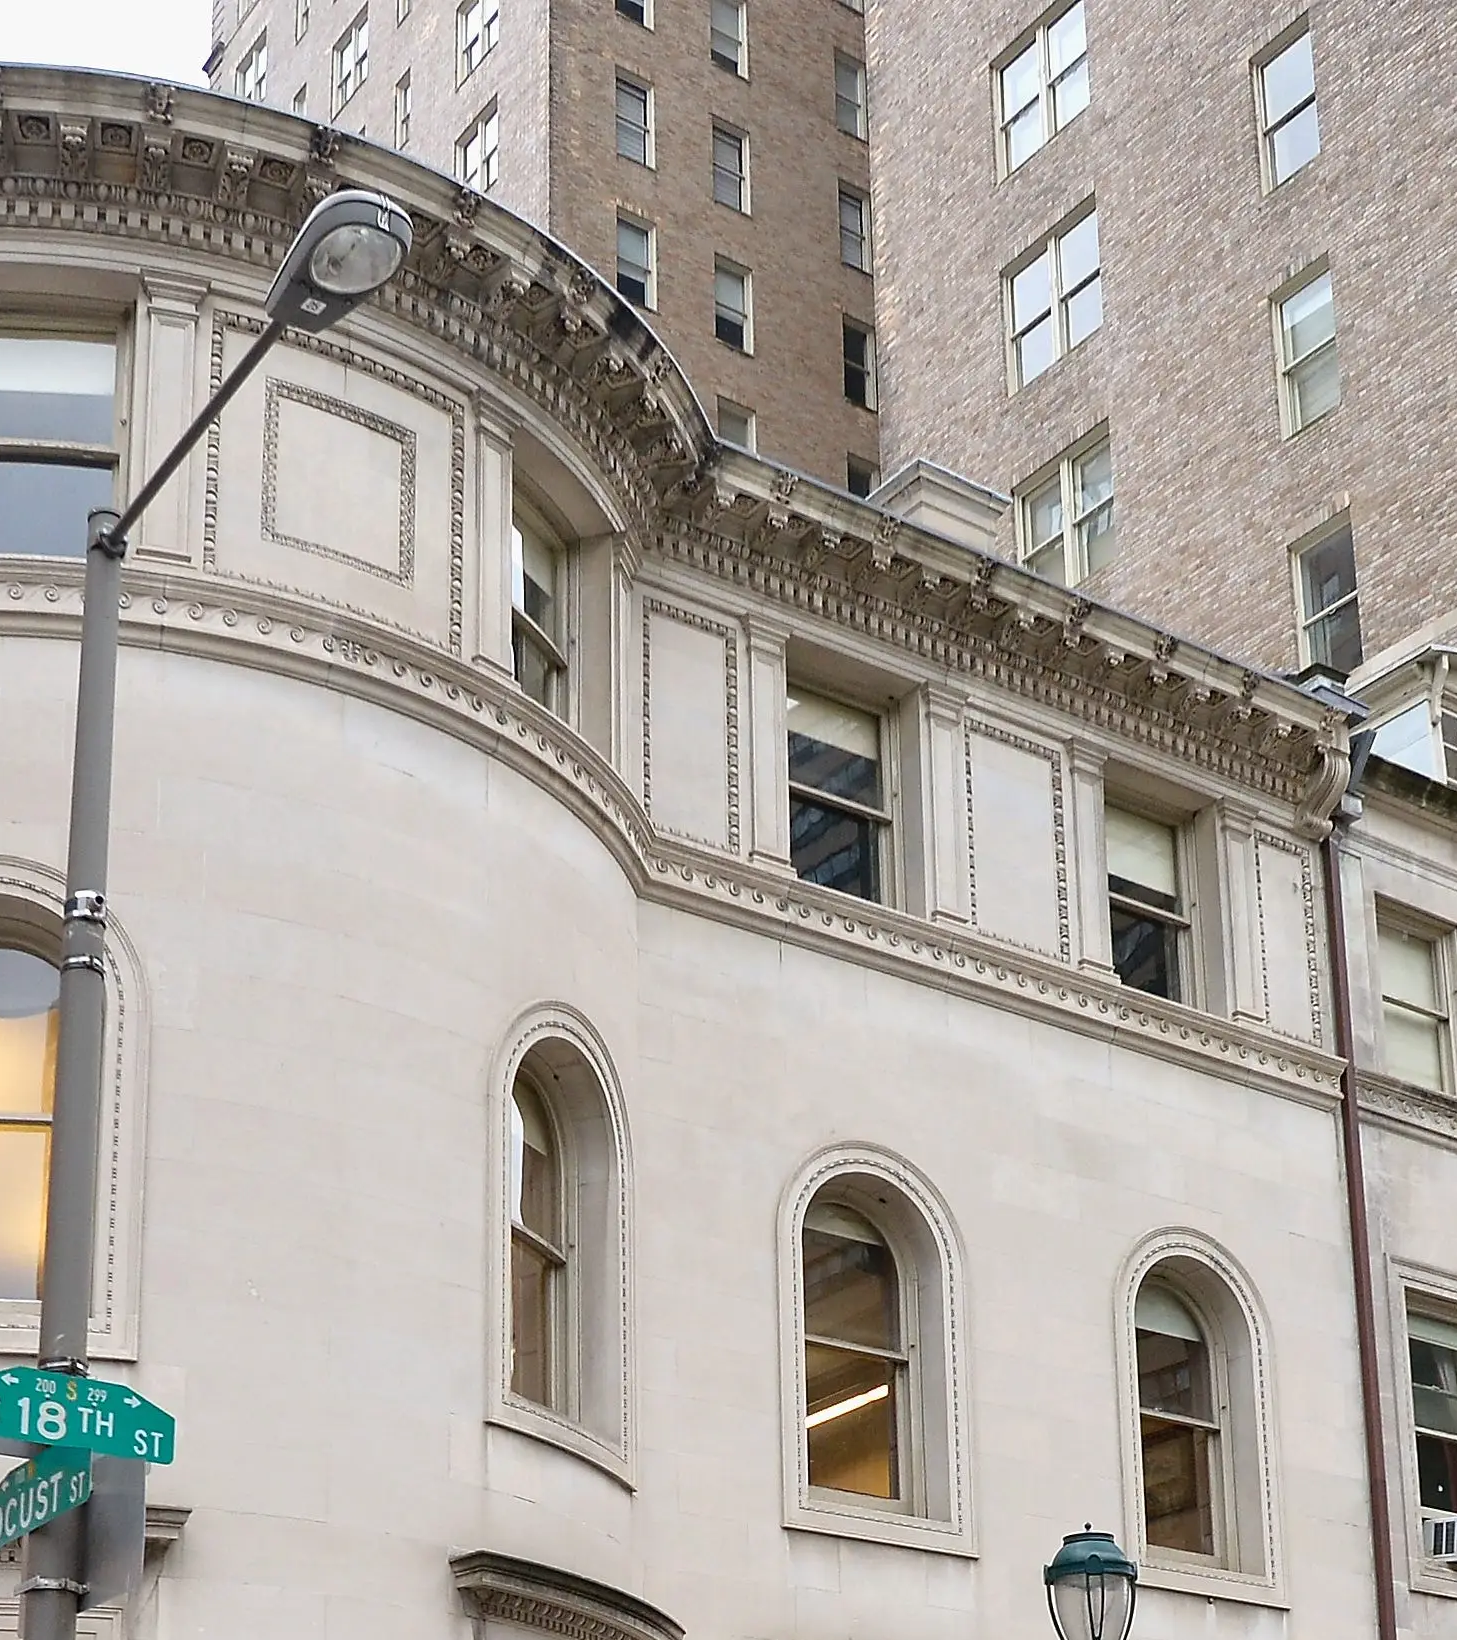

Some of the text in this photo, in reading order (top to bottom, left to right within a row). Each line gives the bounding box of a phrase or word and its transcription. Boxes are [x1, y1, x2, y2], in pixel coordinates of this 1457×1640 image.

[35, 1377, 57, 1395] 200
[87, 1387, 108, 1403] 299
[133, 1429, 164, 1458] ST
[69, 1471, 86, 1504] ST
